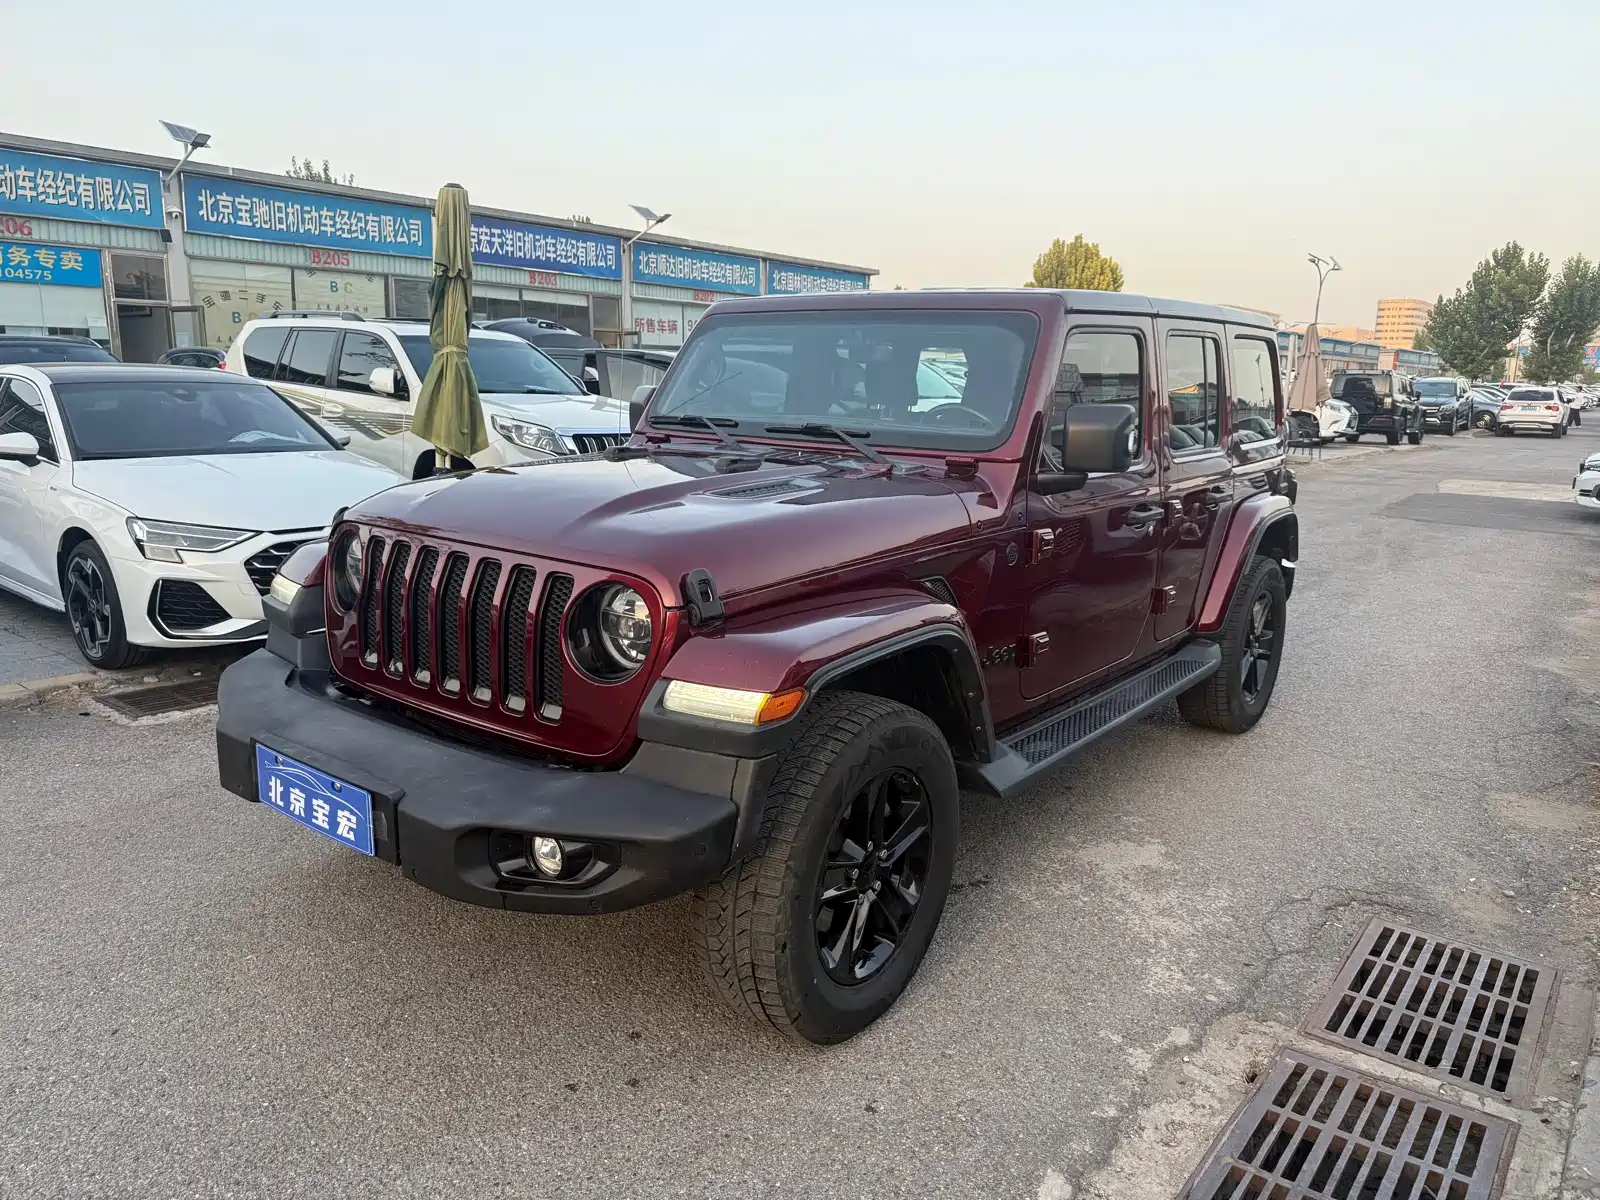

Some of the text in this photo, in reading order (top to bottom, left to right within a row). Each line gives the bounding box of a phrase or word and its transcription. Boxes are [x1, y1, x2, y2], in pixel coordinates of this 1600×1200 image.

[0, 164, 152, 216] 动车经纪有限公司
[197, 189, 424, 247] 北京宝驰旧机动车经纪有限公司
[0, 245, 83, 271] 务专卖
[312, 248, 350, 267] B205
[638, 250, 756, 288] 北京顺达旧机动车经纪有限公司
[0, 267, 52, 280] 04575
[528, 271, 558, 287] B203
[635, 317, 678, 335] 所售车辆
[268, 775, 357, 842] 北京宝宏
